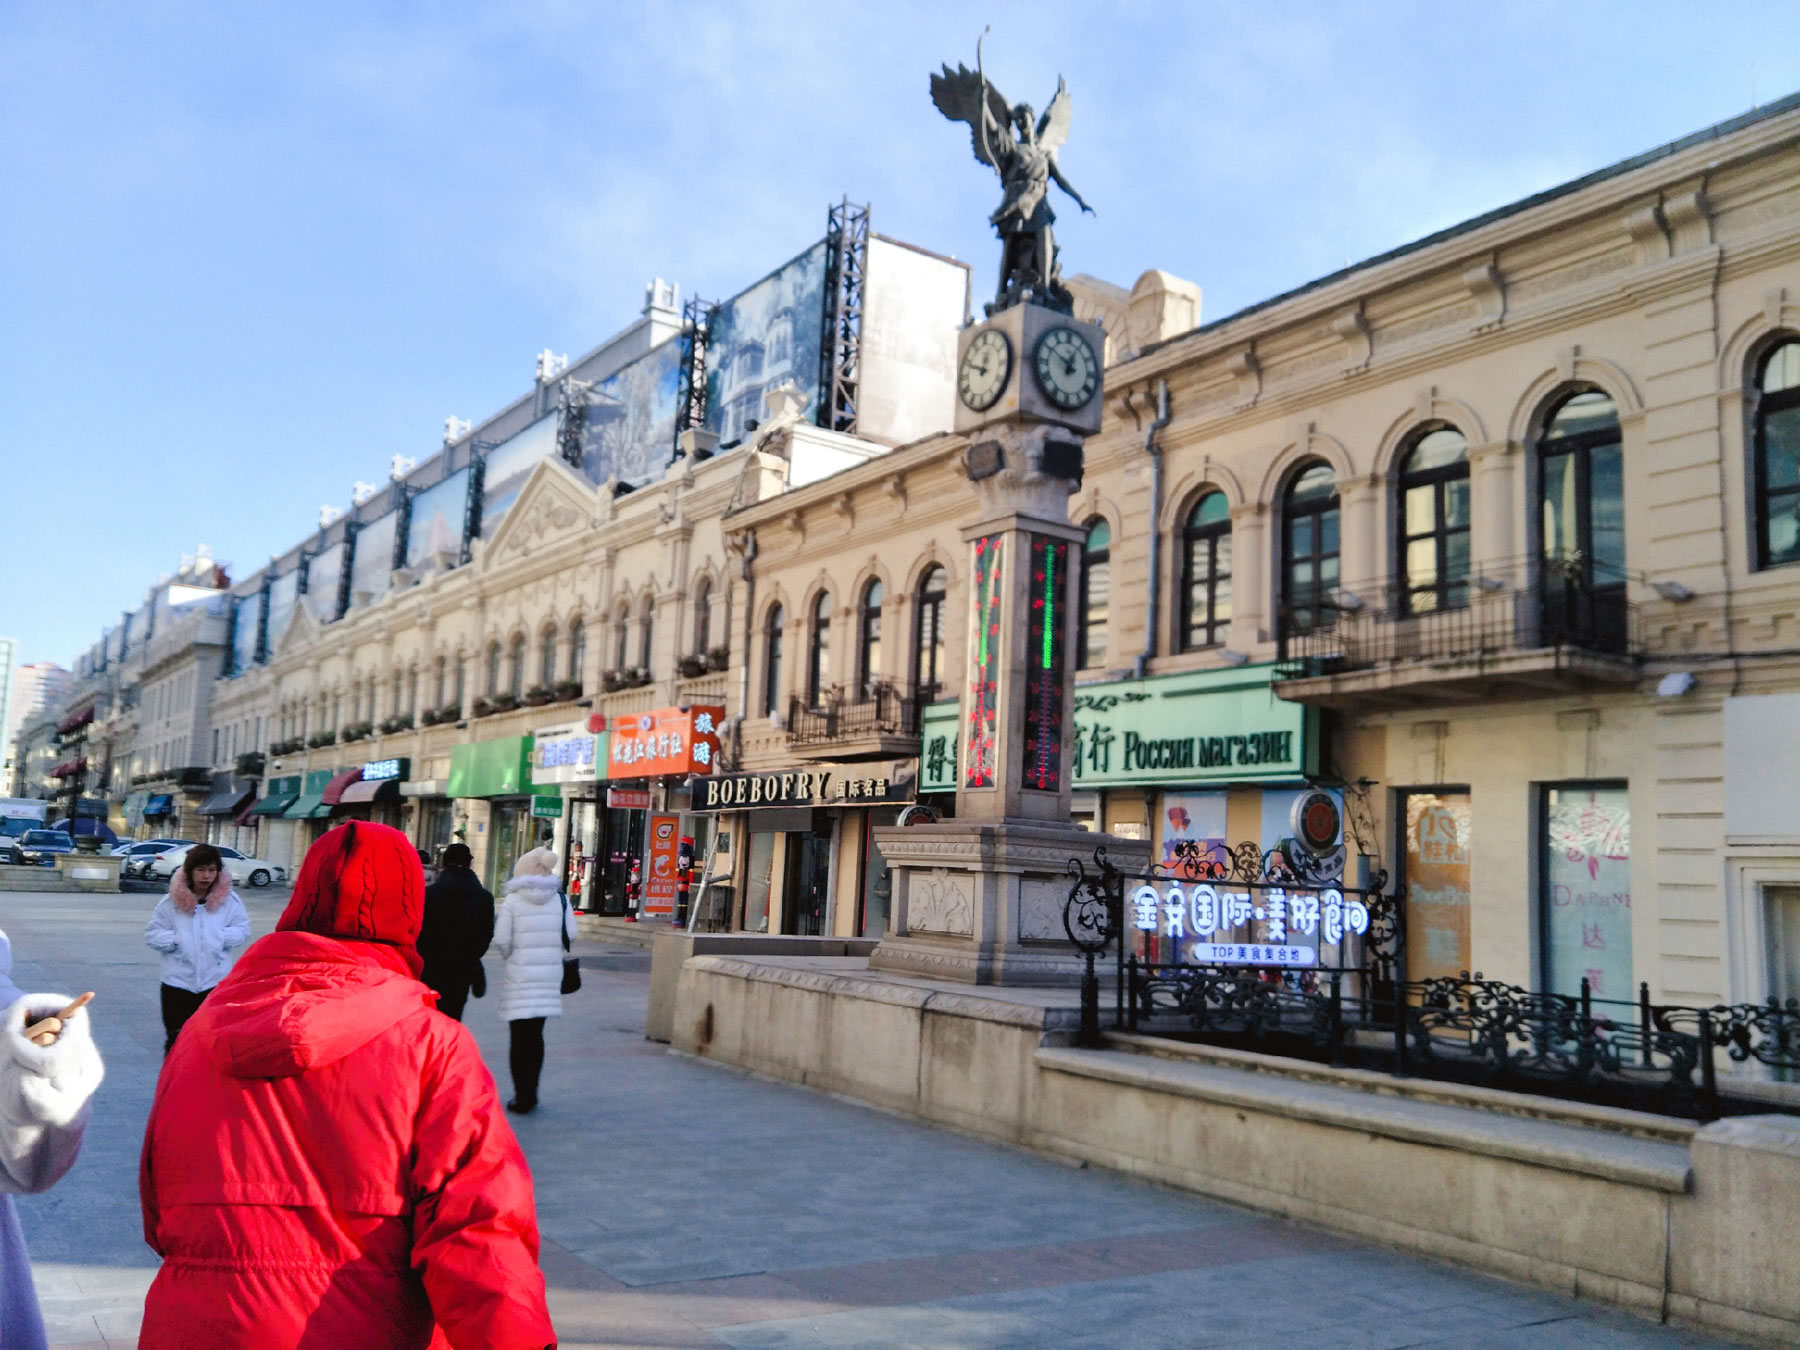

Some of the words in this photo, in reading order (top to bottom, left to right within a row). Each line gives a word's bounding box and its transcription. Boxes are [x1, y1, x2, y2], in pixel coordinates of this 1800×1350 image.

[694, 713, 715, 764] 旅游
[706, 772, 831, 806] BOEBOFRY
[835, 779, 888, 798] 国际名品
[1212, 946, 1233, 959] TOP
[1237, 946, 1300, 962] 美食集合地
